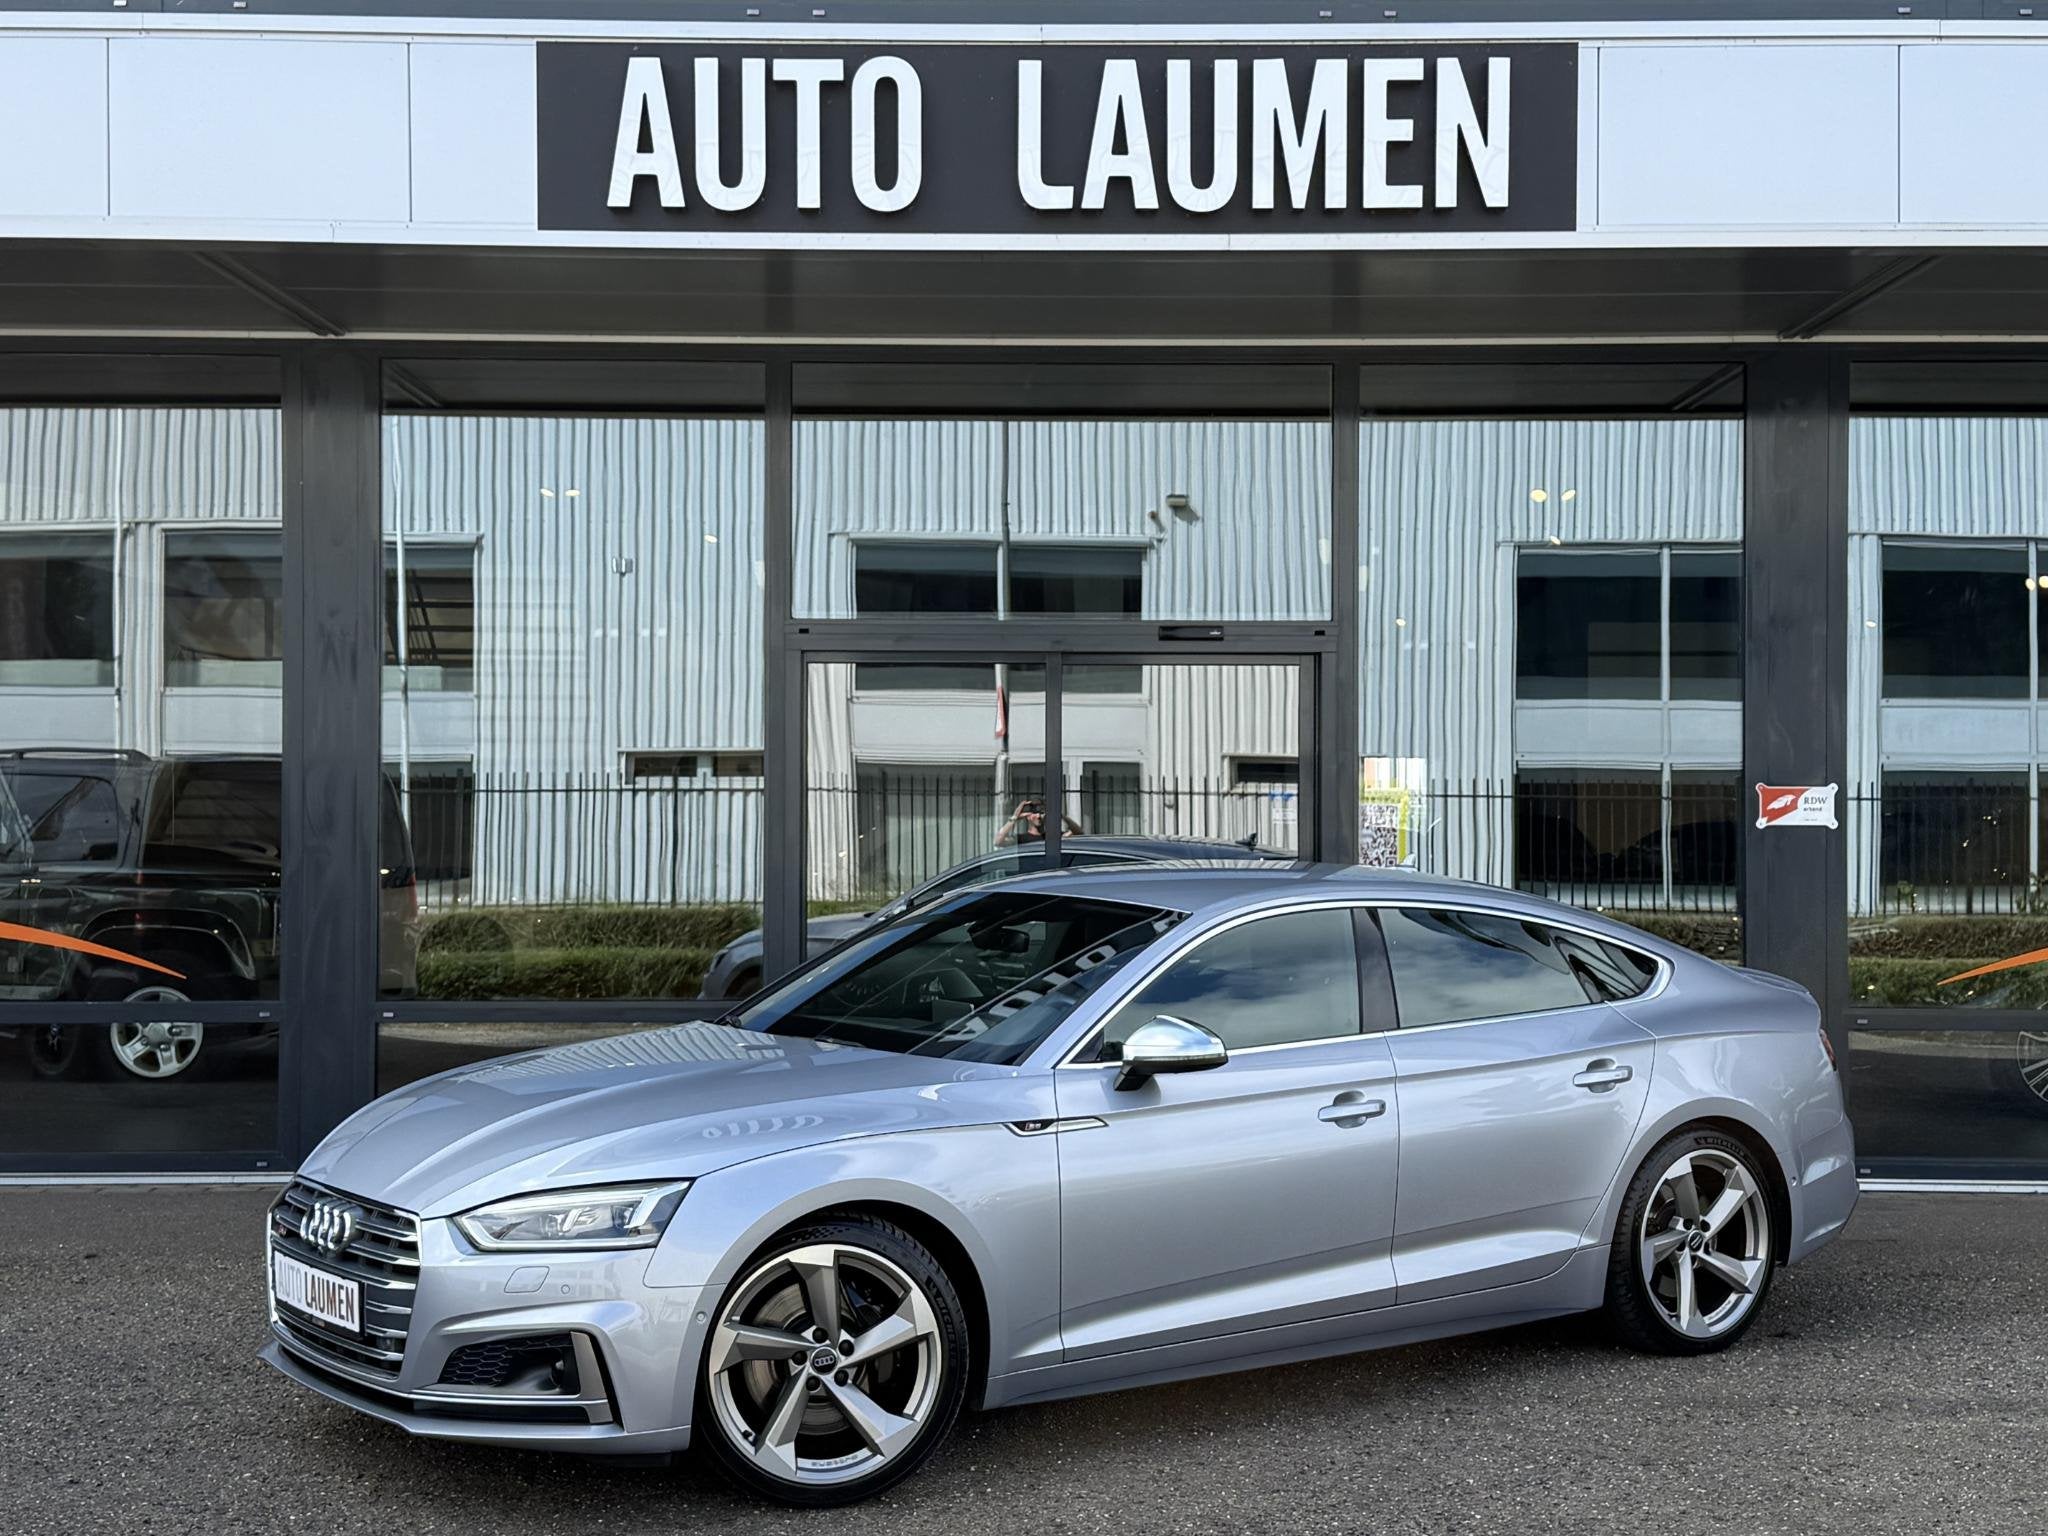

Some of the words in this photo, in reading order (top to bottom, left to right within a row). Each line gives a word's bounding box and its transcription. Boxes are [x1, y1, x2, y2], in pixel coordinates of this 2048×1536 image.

[607, 56, 921, 212] AUTO
[1018, 57, 1511, 213] LAUMEN
[1804, 796, 1828, 805] RDW
[277, 1260, 302, 1304] AUTO
[305, 1271, 354, 1323] LAUMEN
